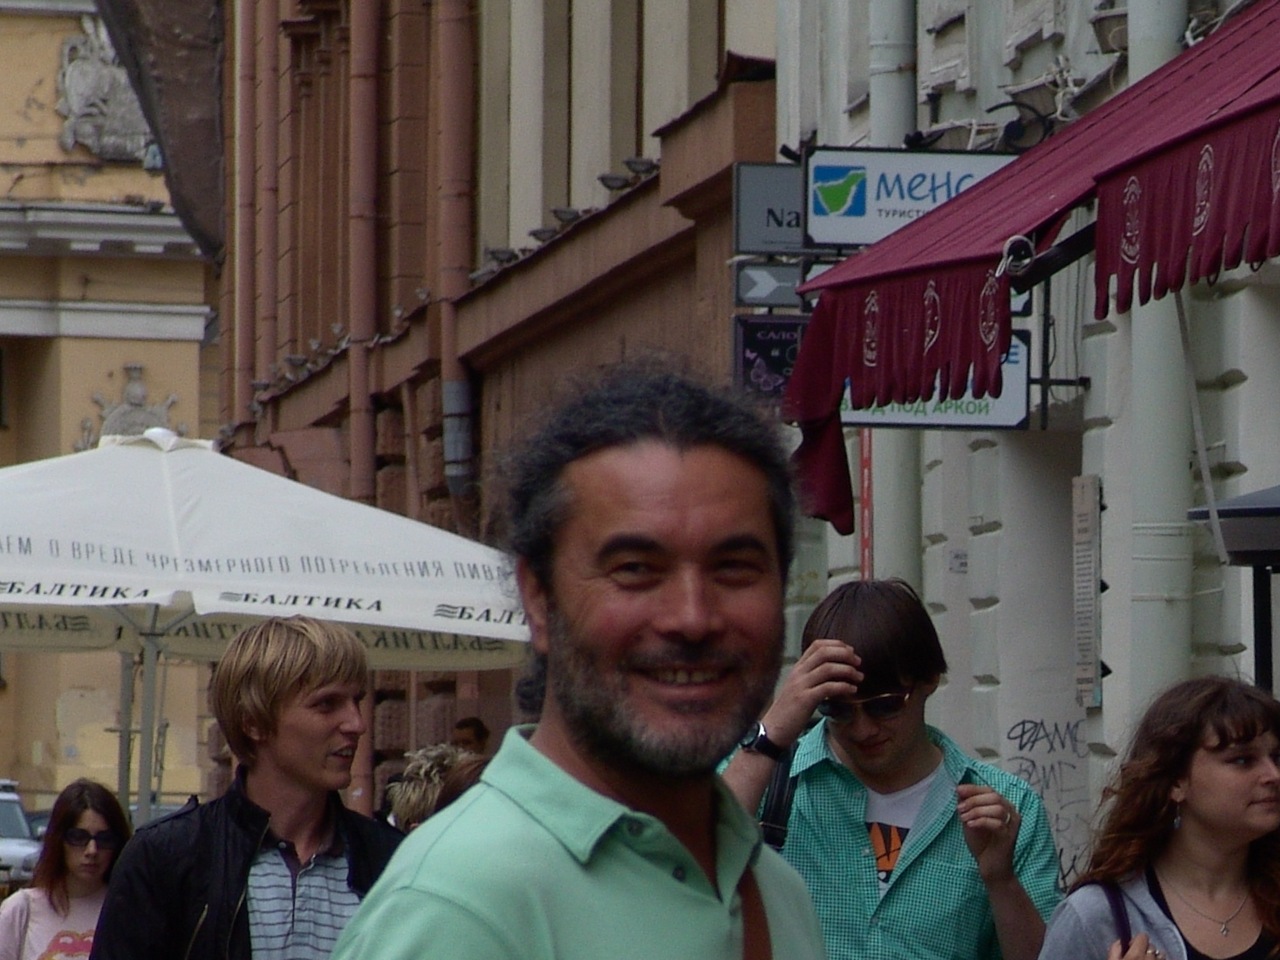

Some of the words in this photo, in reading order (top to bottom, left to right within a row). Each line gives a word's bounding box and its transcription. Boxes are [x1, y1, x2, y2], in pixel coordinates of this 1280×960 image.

[766, 207, 800, 228] Na
[877, 208, 925, 219] ТУРИСТ
[756, 330, 798, 340] САЛО
[932, 398, 990, 415] АРКОЙ
[72, 540, 135, 566] ВРЕДЕ
[146, 551, 290, 574] ЧРЕЗМЕРНОГО
[300, 555, 444, 578] ПОТРЕБЛЕНИЯ
[7, 581, 150, 600] БАЛТИКА
[243, 592, 383, 612] БАЛТИКА
[458, 605, 527, 626] БАЛТ
